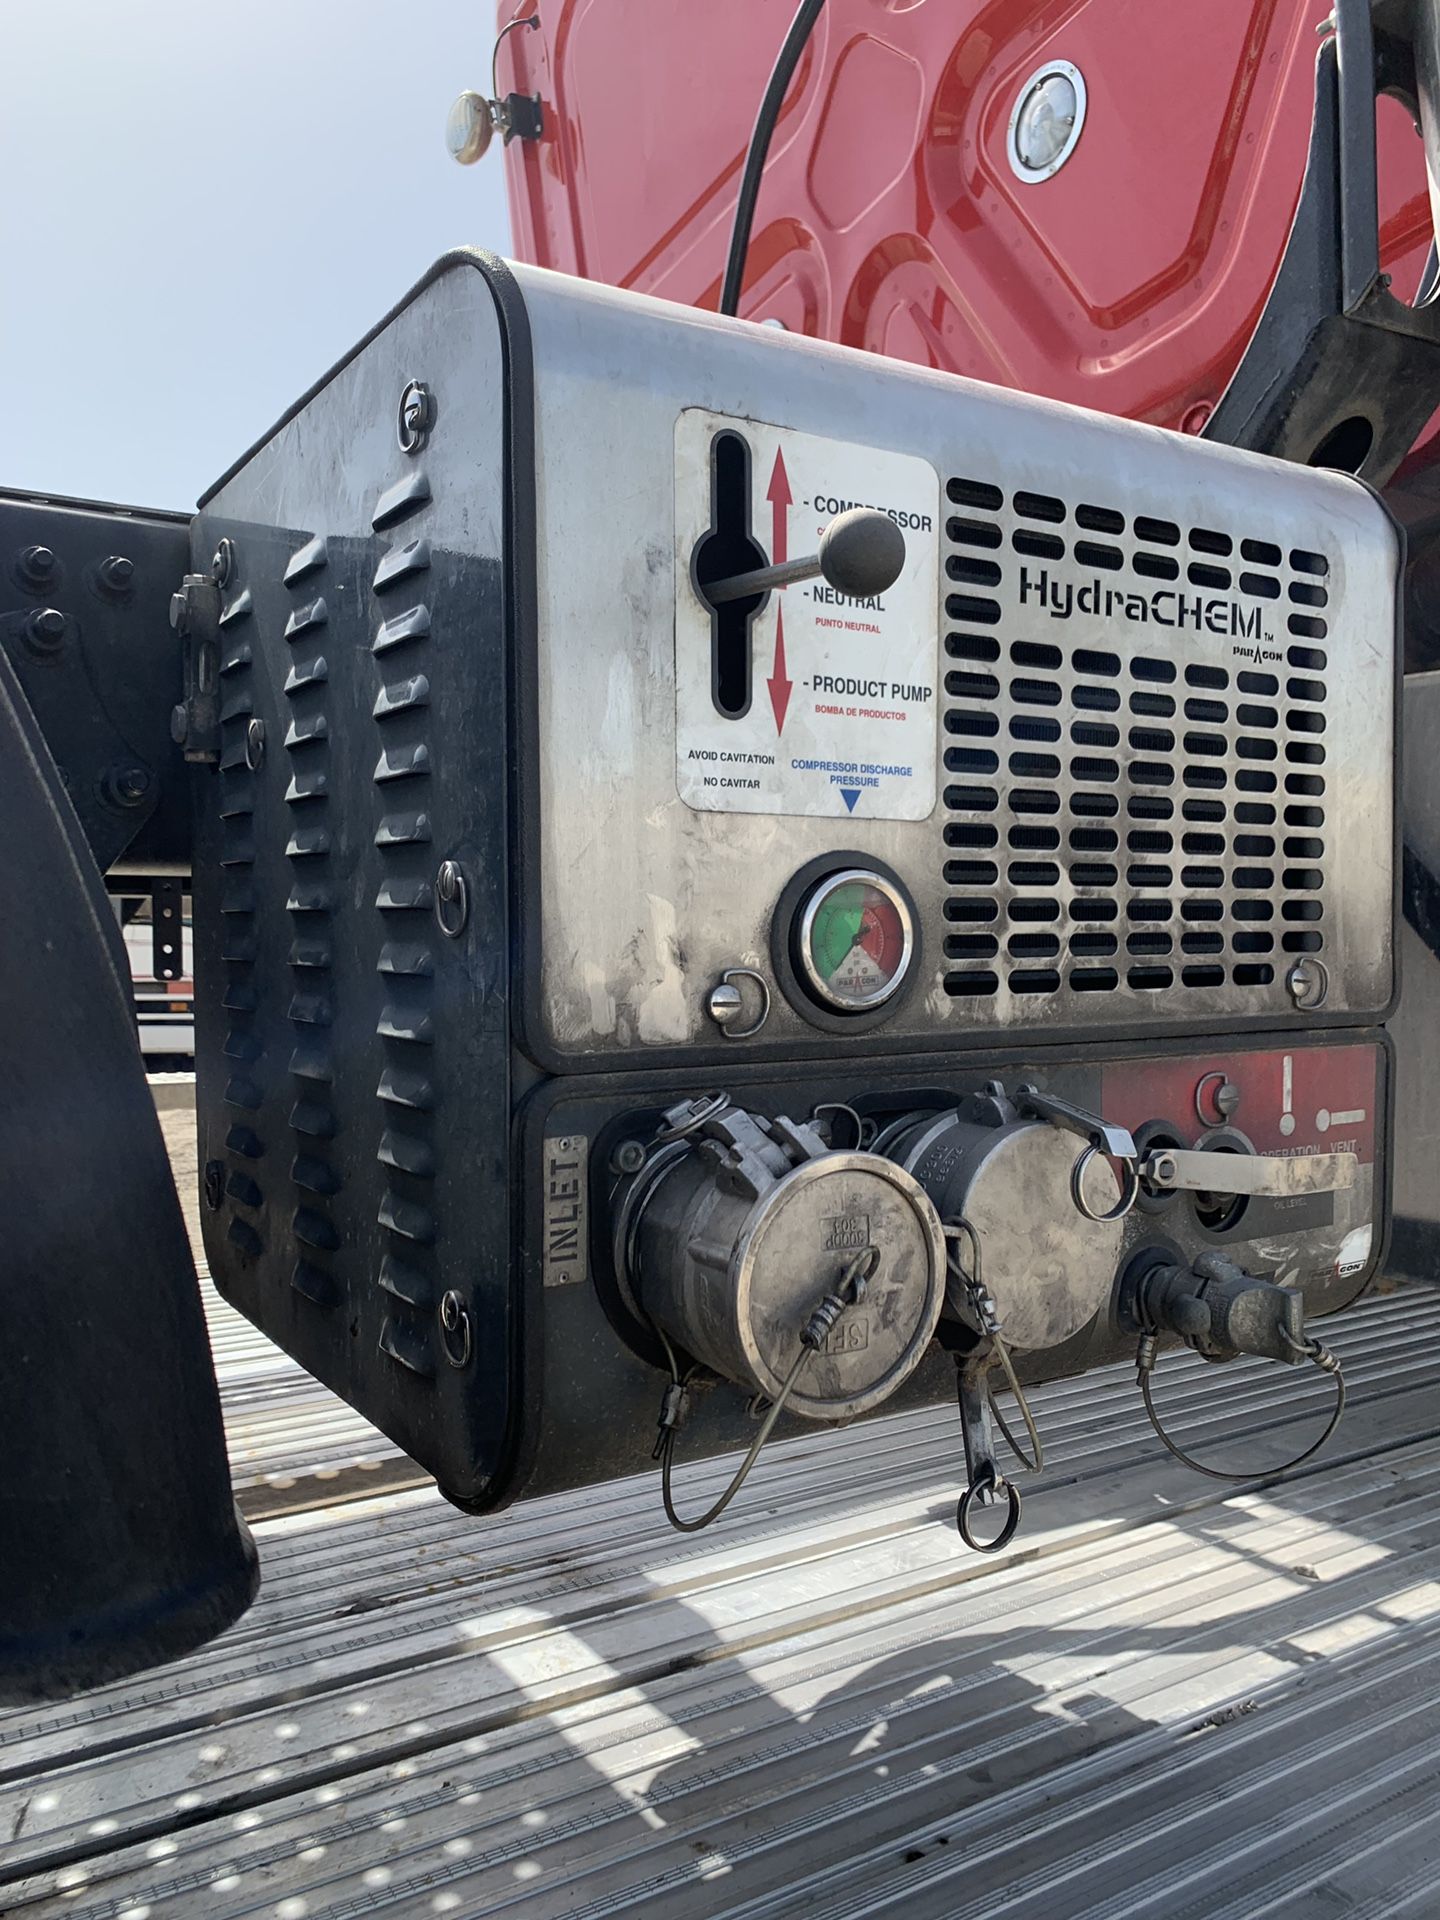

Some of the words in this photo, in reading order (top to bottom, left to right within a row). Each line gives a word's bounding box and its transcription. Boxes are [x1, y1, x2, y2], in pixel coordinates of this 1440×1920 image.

[814, 495, 932, 532] COMSSOR
[1019, 567, 1262, 640] HydraCHEM
[815, 617, 843, 628] PUNTO
[845, 621, 881, 634] NEUTRAL
[1232, 645, 1283, 664] PARAGON
[813, 675, 887, 698] PRODUCT
[891, 684, 932, 702] PUMP
[815, 704, 844, 715] BOMBA
[846, 708, 857, 716] DE
[859, 709, 906, 720] PRODUCTOS
[688, 750, 718, 760] AVOID
[720, 752, 775, 765] CAVITATION
[791, 759, 858, 773] COMPRESSOR
[860, 763, 912, 776] DISCHARGE
[703, 777, 718, 786] NO
[720, 778, 760, 789] CAVITAR
[830, 775, 880, 787] PRESSURE
[1330, 1139, 1357, 1152] VENT
[550, 1159, 579, 1263] INLET
